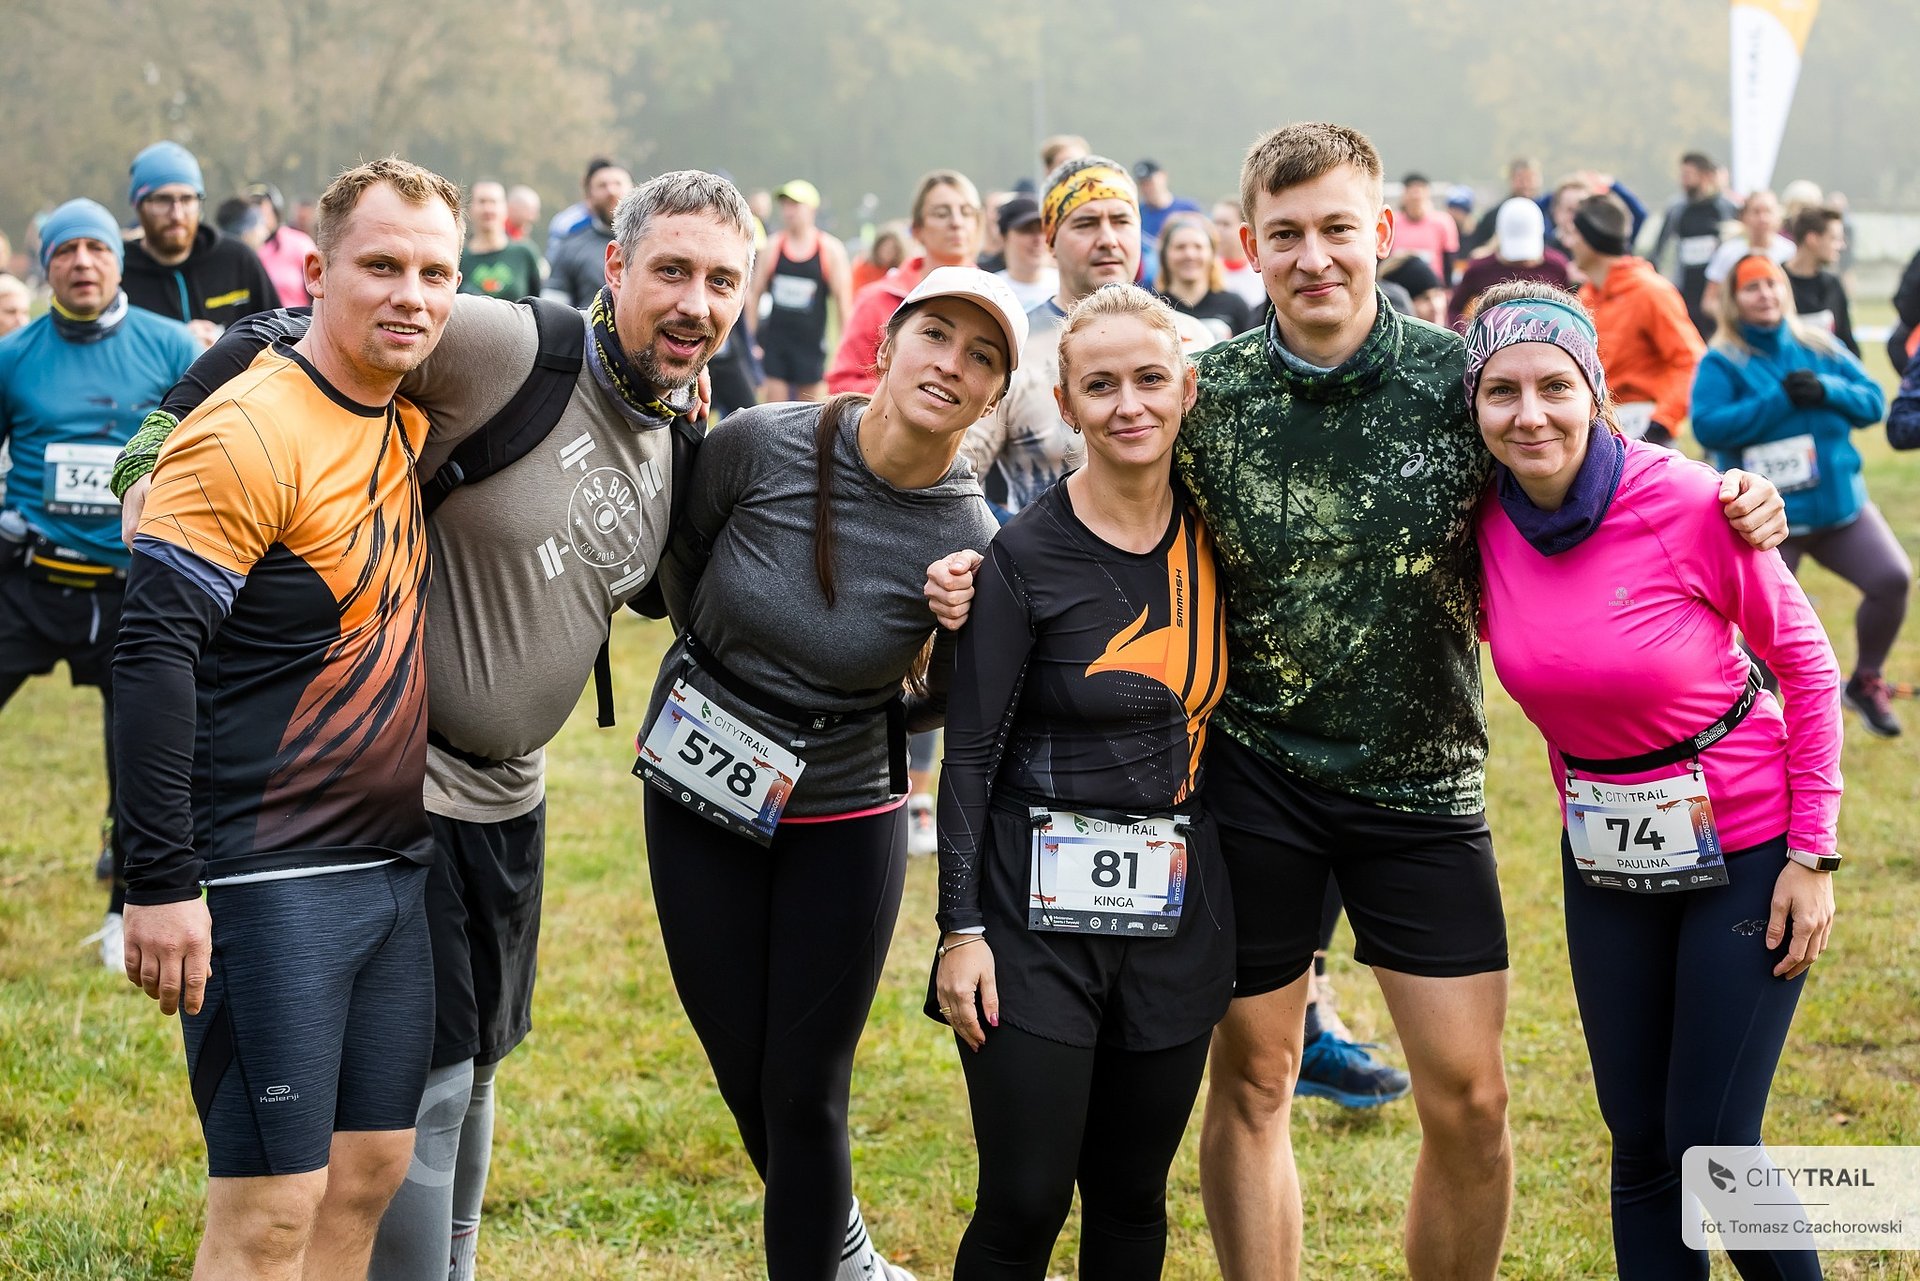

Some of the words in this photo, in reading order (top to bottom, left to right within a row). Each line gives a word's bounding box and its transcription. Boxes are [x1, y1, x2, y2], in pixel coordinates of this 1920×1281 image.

[582, 476, 604, 507] AS
[607, 476, 637, 518] BOX
[580, 541, 595, 557] EST
[595, 550, 615, 562] 2016
[1176, 568, 1184, 629] SMMASH
[677, 729, 757, 798] 578
[766, 789, 784, 823] BYDGOSZCZ
[1605, 817, 1666, 852] 74
[1700, 812, 1715, 853] BYDGOSZCZ
[1091, 849, 1139, 890] 81
[1174, 858, 1183, 901] BYDGOSZCZ
[1616, 858, 1670, 869] PAULINA
[1093, 895, 1135, 908] KINGA
[259, 1093, 300, 1103] Kalenji
